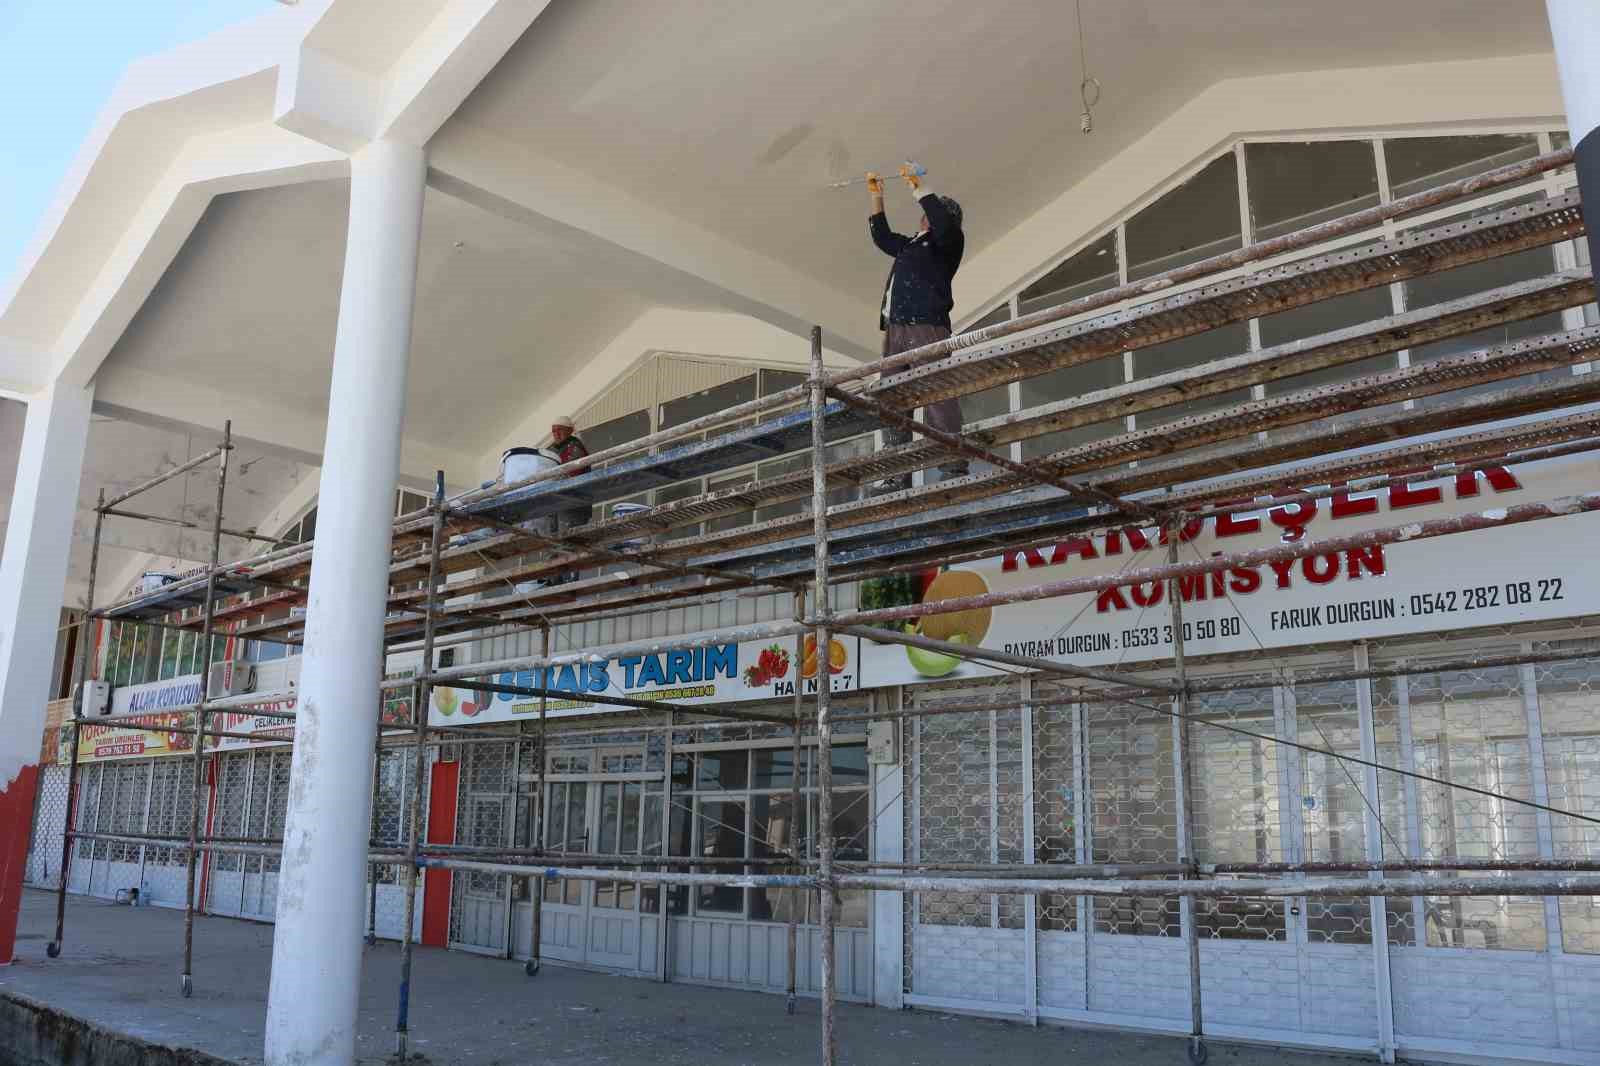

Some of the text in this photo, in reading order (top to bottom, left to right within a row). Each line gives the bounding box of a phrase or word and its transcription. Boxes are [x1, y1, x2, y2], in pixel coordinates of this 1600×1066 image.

[1271, 606, 1323, 631] FARUK
[1326, 597, 1396, 625] DURGUN
[1410, 590, 1458, 616] 0542
[1463, 585, 1500, 611] 282
[1506, 582, 1531, 605] 08
[1538, 577, 1564, 601] 22
[1057, 632, 1112, 655] DURGUN
[1122, 627, 1159, 649] 0533
[1163, 622, 1193, 644] 30
[1196, 619, 1218, 640] 50
[1220, 616, 1241, 637] 80
[618, 642, 738, 689] TARIM
[128, 689, 157, 713] ALLAH
[774, 681, 796, 697] HA
